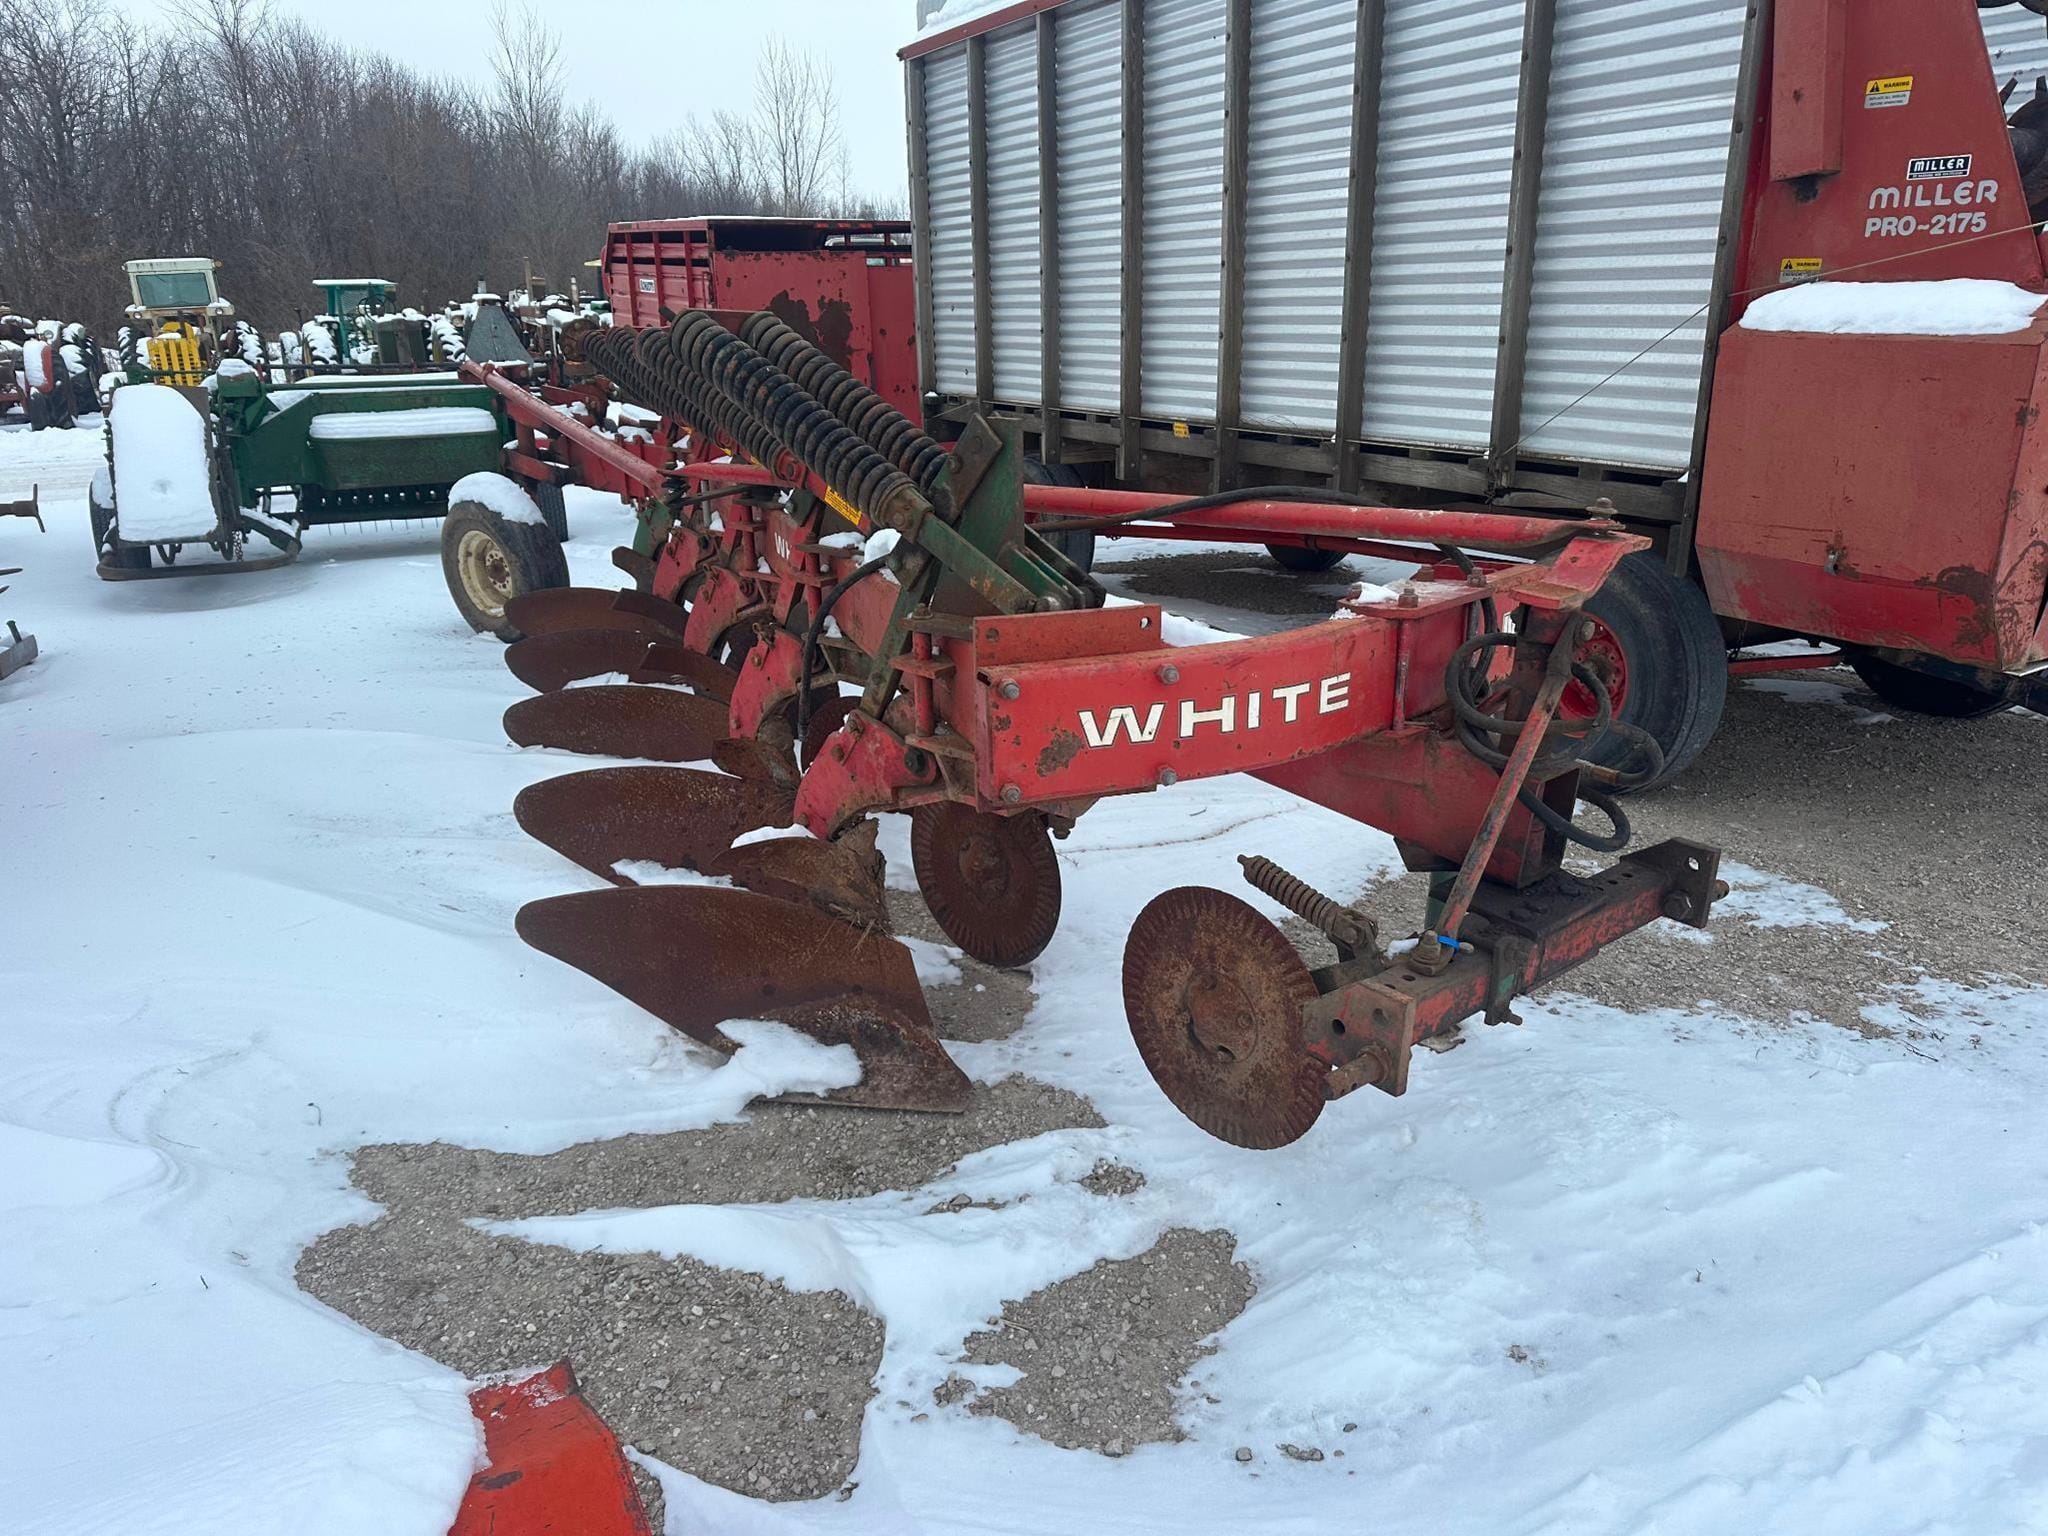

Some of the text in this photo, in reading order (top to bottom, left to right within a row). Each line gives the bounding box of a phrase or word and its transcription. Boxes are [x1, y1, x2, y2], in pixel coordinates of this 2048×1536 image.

[1914, 158, 1964, 172] MILLER
[1868, 179, 1998, 210] MILLER
[1078, 671, 1352, 749] WHITE
